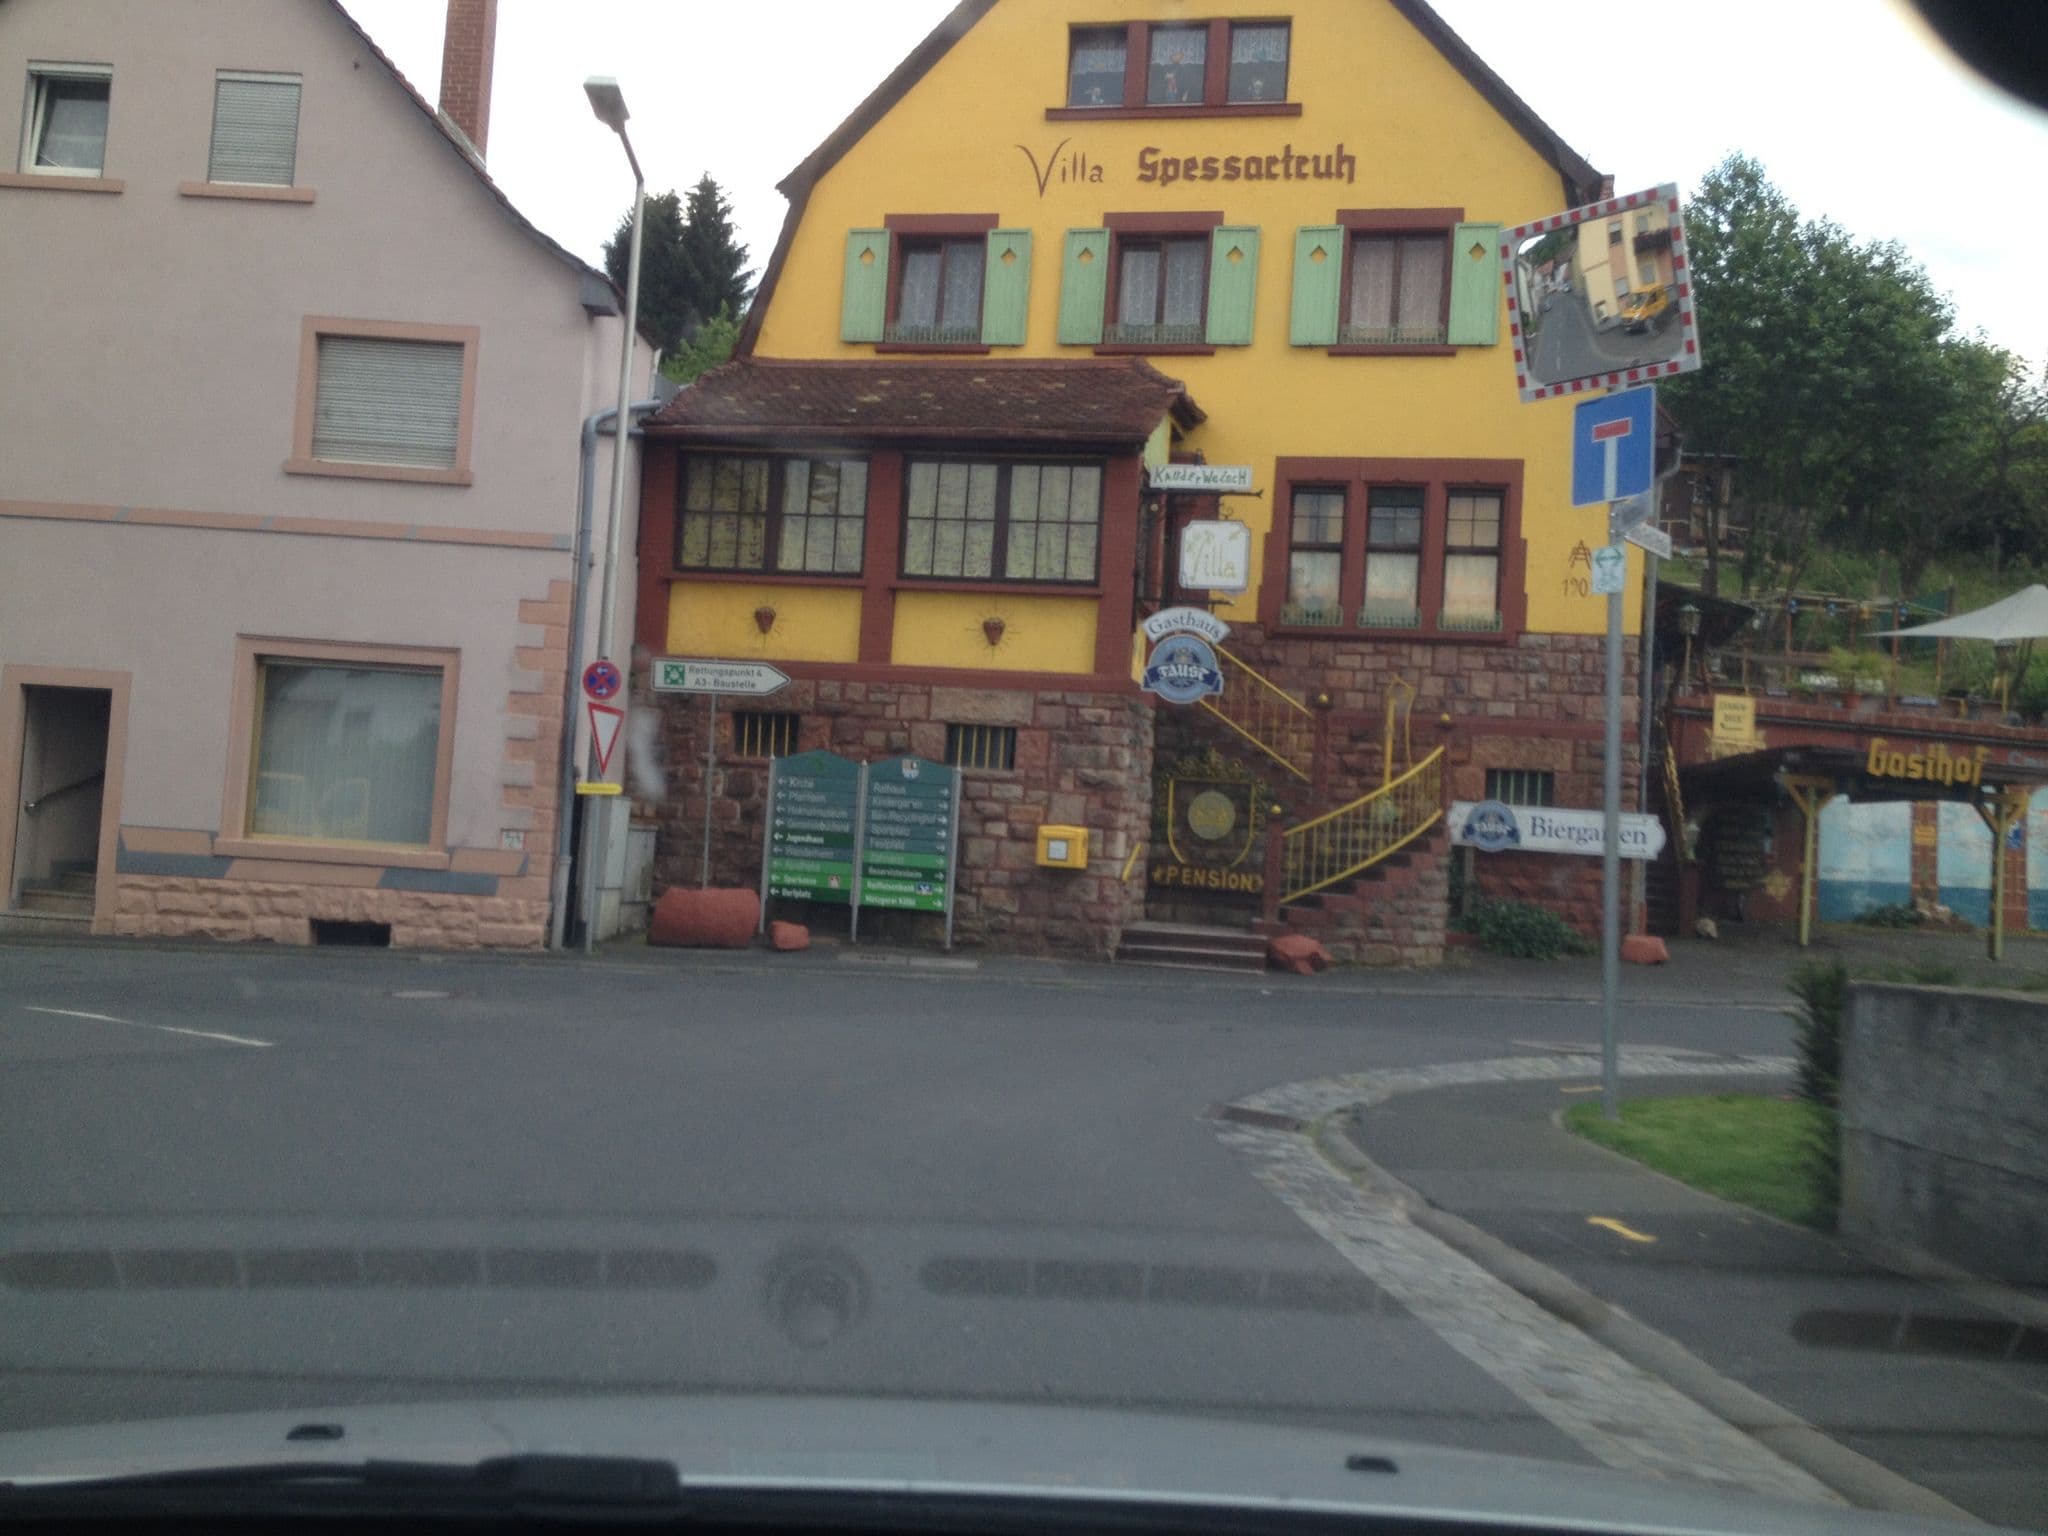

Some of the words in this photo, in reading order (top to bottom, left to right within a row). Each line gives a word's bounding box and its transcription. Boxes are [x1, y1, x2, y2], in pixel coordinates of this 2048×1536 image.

[1015, 138, 1104, 199] Villa
[1149, 611, 1222, 640] Gasthaus
[1157, 663, 1211, 682] FAUST
[1531, 815, 1649, 845] Biergaren
[1167, 866, 1254, 891] PENSION
